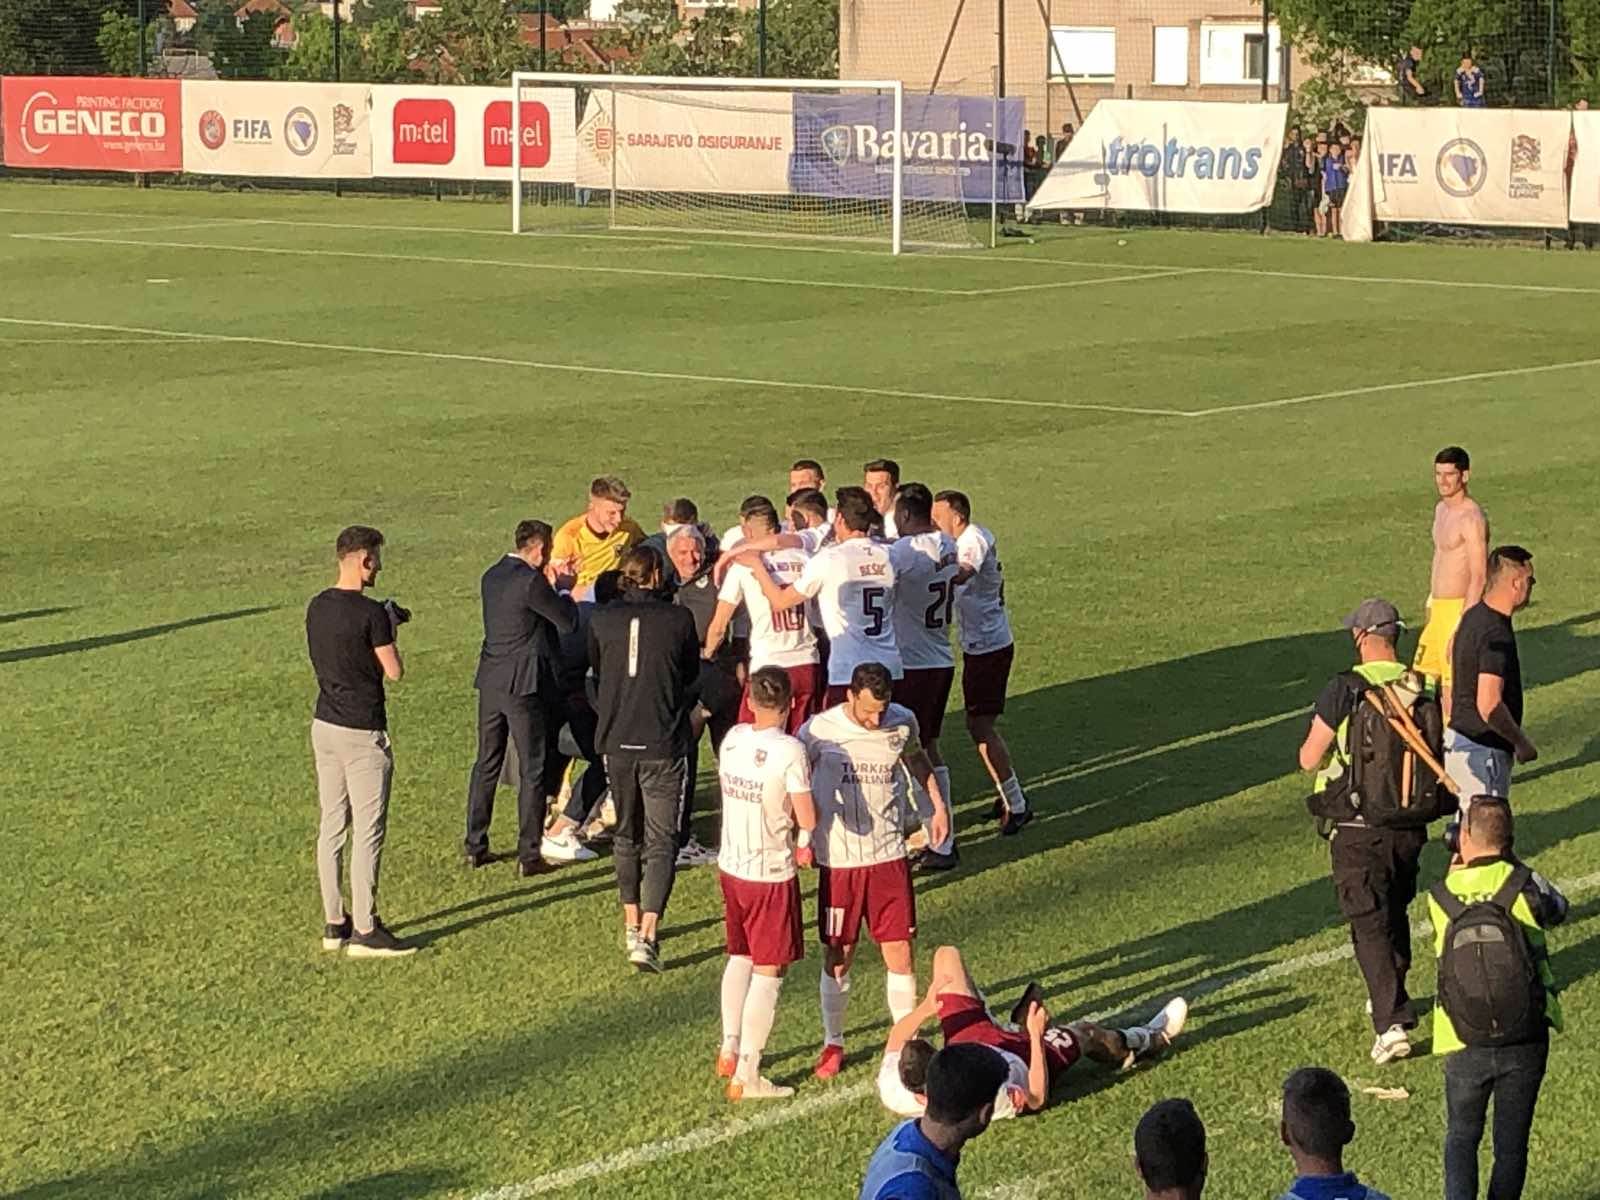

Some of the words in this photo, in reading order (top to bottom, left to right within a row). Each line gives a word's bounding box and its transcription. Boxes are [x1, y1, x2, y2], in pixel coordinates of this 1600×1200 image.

[76, 95, 120, 109] PRINTING
[122, 96, 163, 110] FACTORY
[34, 109, 166, 138] GENECO
[233, 119, 272, 139] FIFA
[399, 118, 448, 144] m:tel
[490, 120, 543, 147] m:el
[627, 133, 693, 148] SARAJEVO
[698, 134, 782, 150] OSIGURANJE
[854, 121, 990, 162] Bavaria
[863, 587, 885, 636] 5
[841, 762, 893, 773] TURKIS
[825, 907, 845, 937] 11
